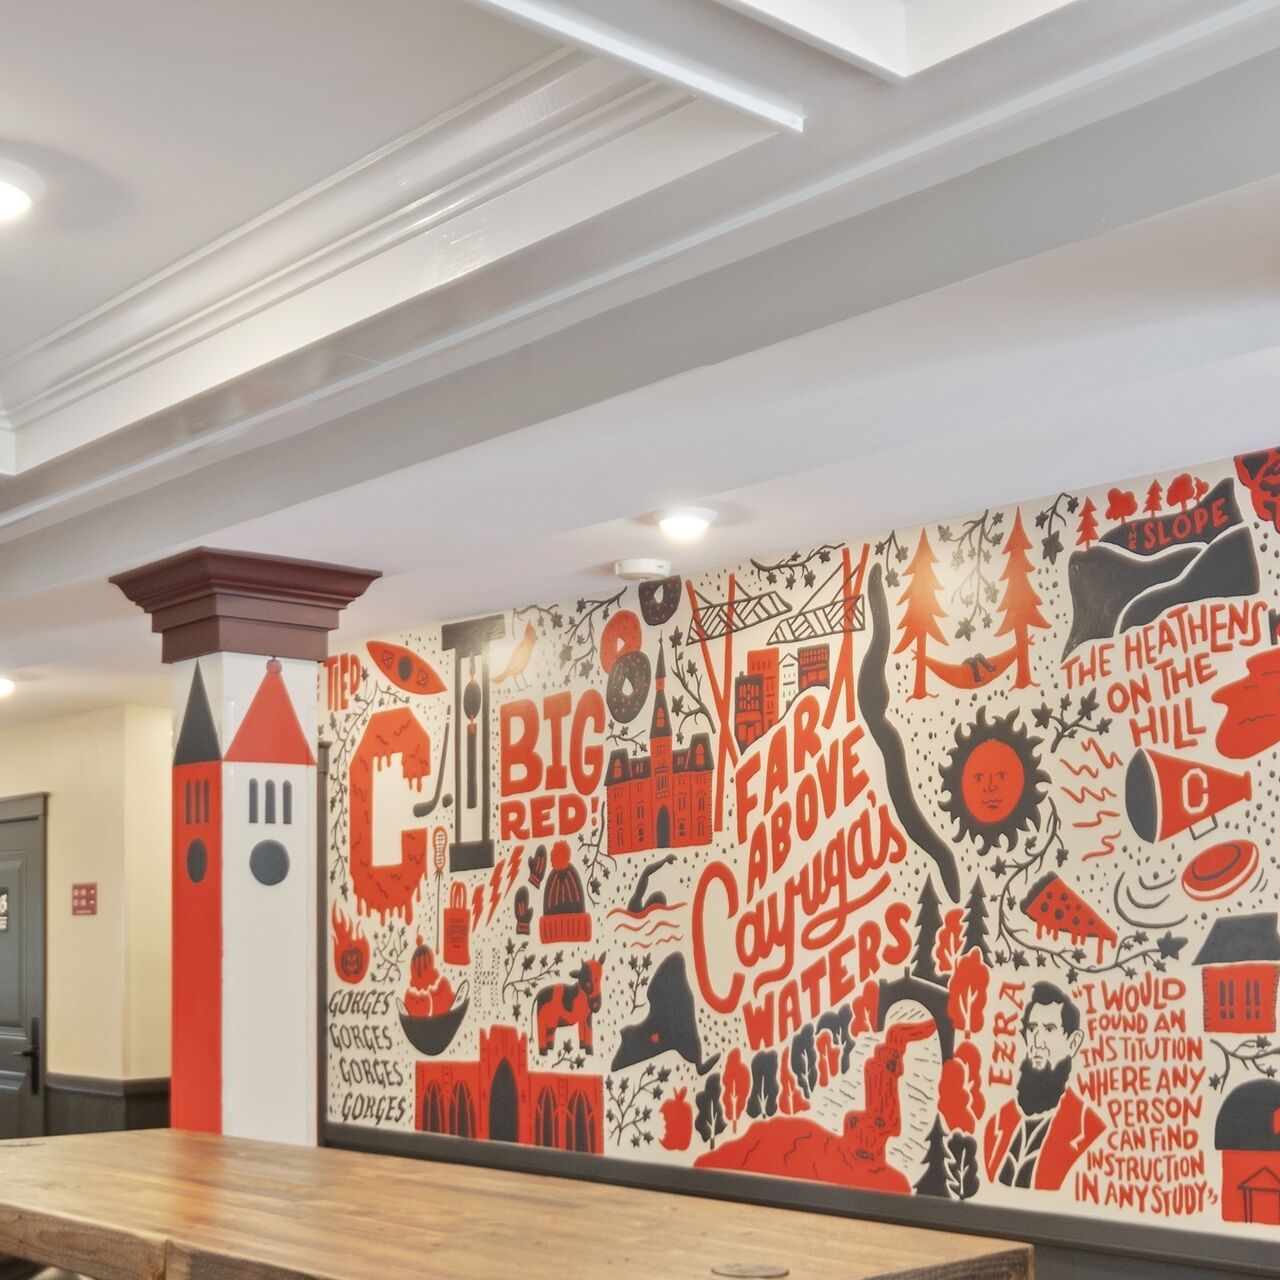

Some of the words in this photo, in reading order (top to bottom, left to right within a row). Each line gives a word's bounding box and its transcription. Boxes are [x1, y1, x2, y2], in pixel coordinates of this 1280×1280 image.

[1143, 498, 1229, 550] SLOPE
[1060, 643, 1115, 690] THE
[1125, 600, 1268, 673] HEATHENS
[1107, 672, 1152, 714] ON
[1154, 652, 1218, 700] THE
[500, 688, 606, 797] BIG
[1129, 697, 1207, 750] HILL
[736, 695, 822, 845] FAR
[1182, 768, 1209, 815] C
[501, 793, 600, 841] RED!
[747, 725, 871, 904] ABOVE
[691, 789, 908, 1014] Cayuga's
[742, 902, 913, 1052] WATERS
[1101, 970, 1187, 1013] WOULD
[329, 989, 396, 1018] GORGES
[1087, 1013, 1148, 1041] FOUND
[1154, 1008, 1187, 1033] AN
[329, 1023, 393, 1054] GORGES
[989, 980, 1025, 1087] EZRA
[1080, 1034, 1203, 1068] INSTITUTION
[339, 1057, 404, 1089] GORGES
[1077, 1065, 1151, 1107] WHERE
[1156, 1063, 1206, 1095] ANY
[341, 1092, 407, 1122] GORGES
[1107, 1095, 1203, 1128] PERSON
[1107, 1126, 1145, 1151] CAN
[1150, 1124, 1199, 1152] FIND
[1087, 1149, 1205, 1184] INSTRUCTION
[1075, 1171, 1099, 1206] IN
[1104, 1180, 1148, 1214] ANY
